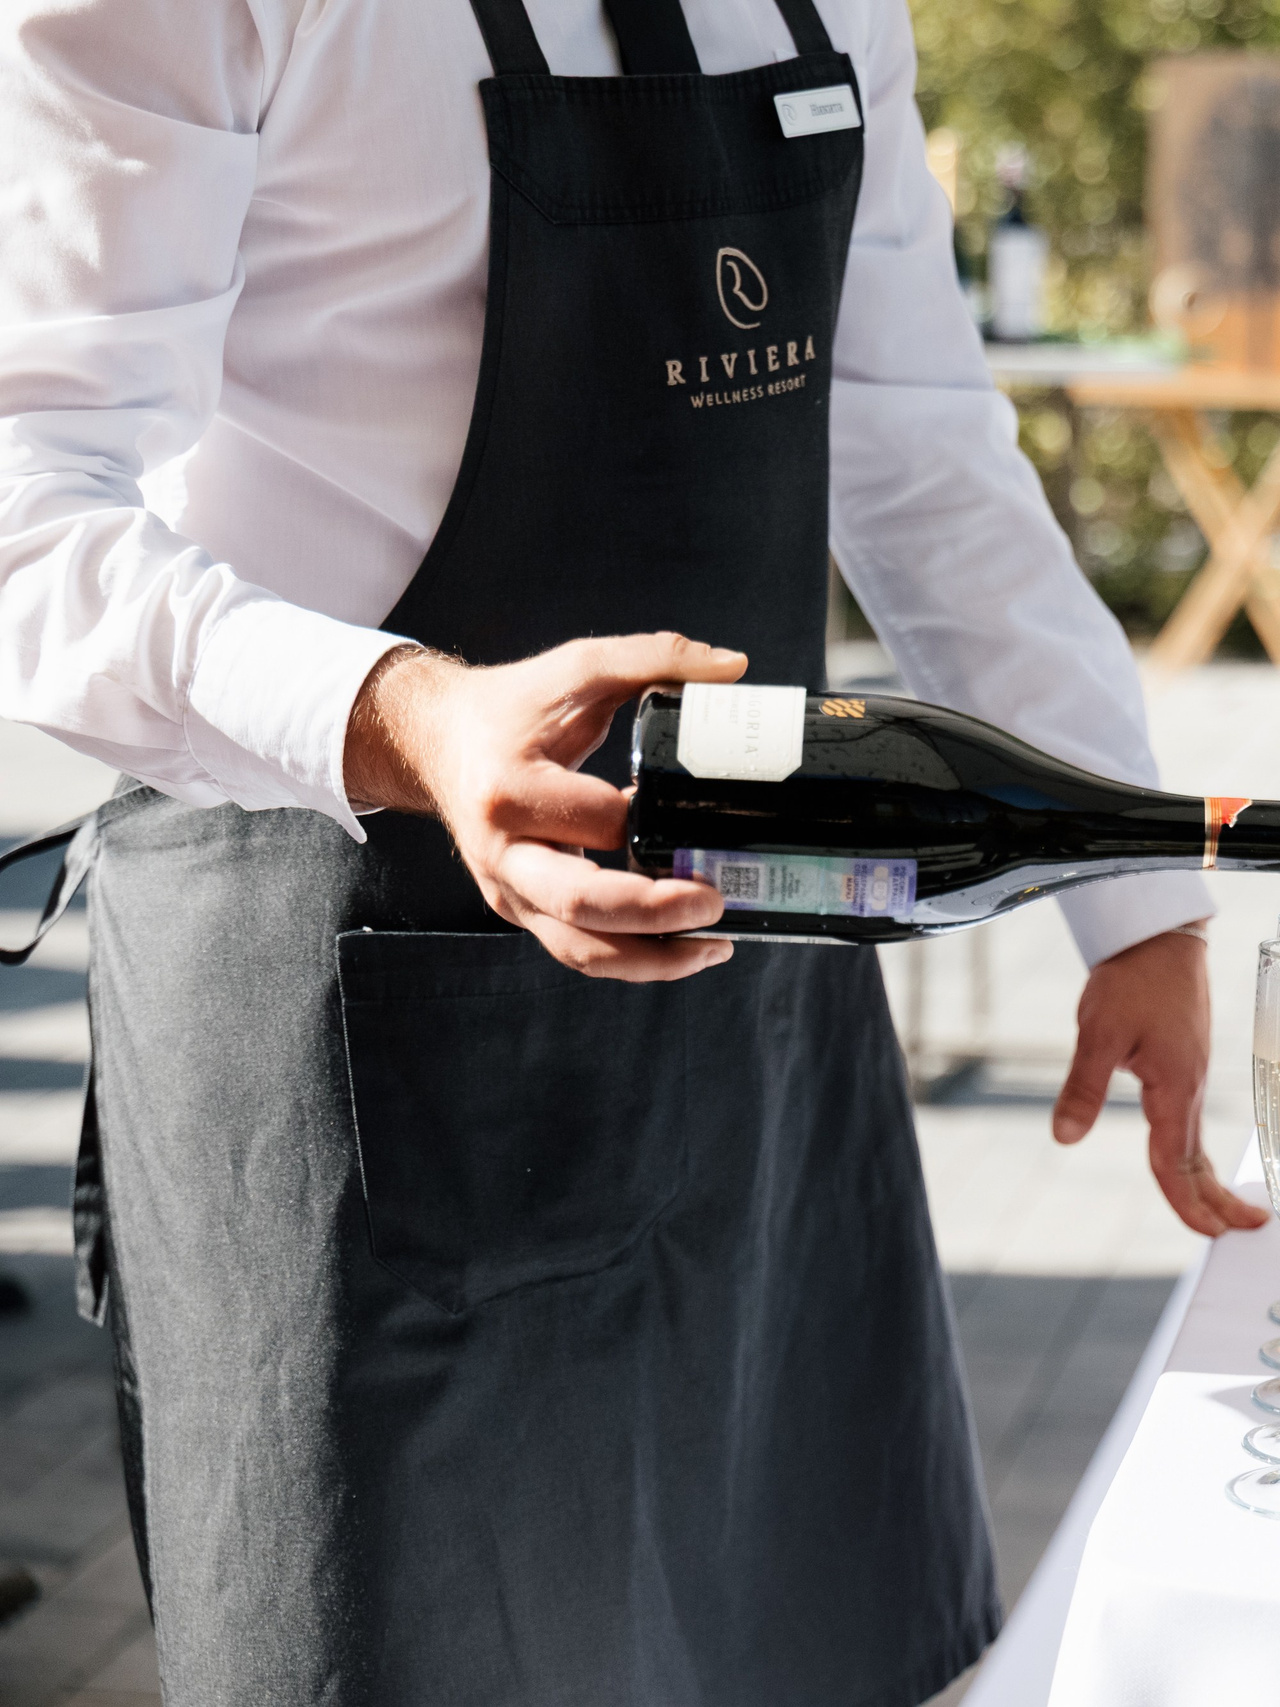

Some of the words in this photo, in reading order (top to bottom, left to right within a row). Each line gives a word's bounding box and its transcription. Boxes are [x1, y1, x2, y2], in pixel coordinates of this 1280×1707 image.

[665, 335, 816, 386] RIVIERA
[690, 385, 764, 408] WELLNESS
[767, 374, 807, 396] RESORT
